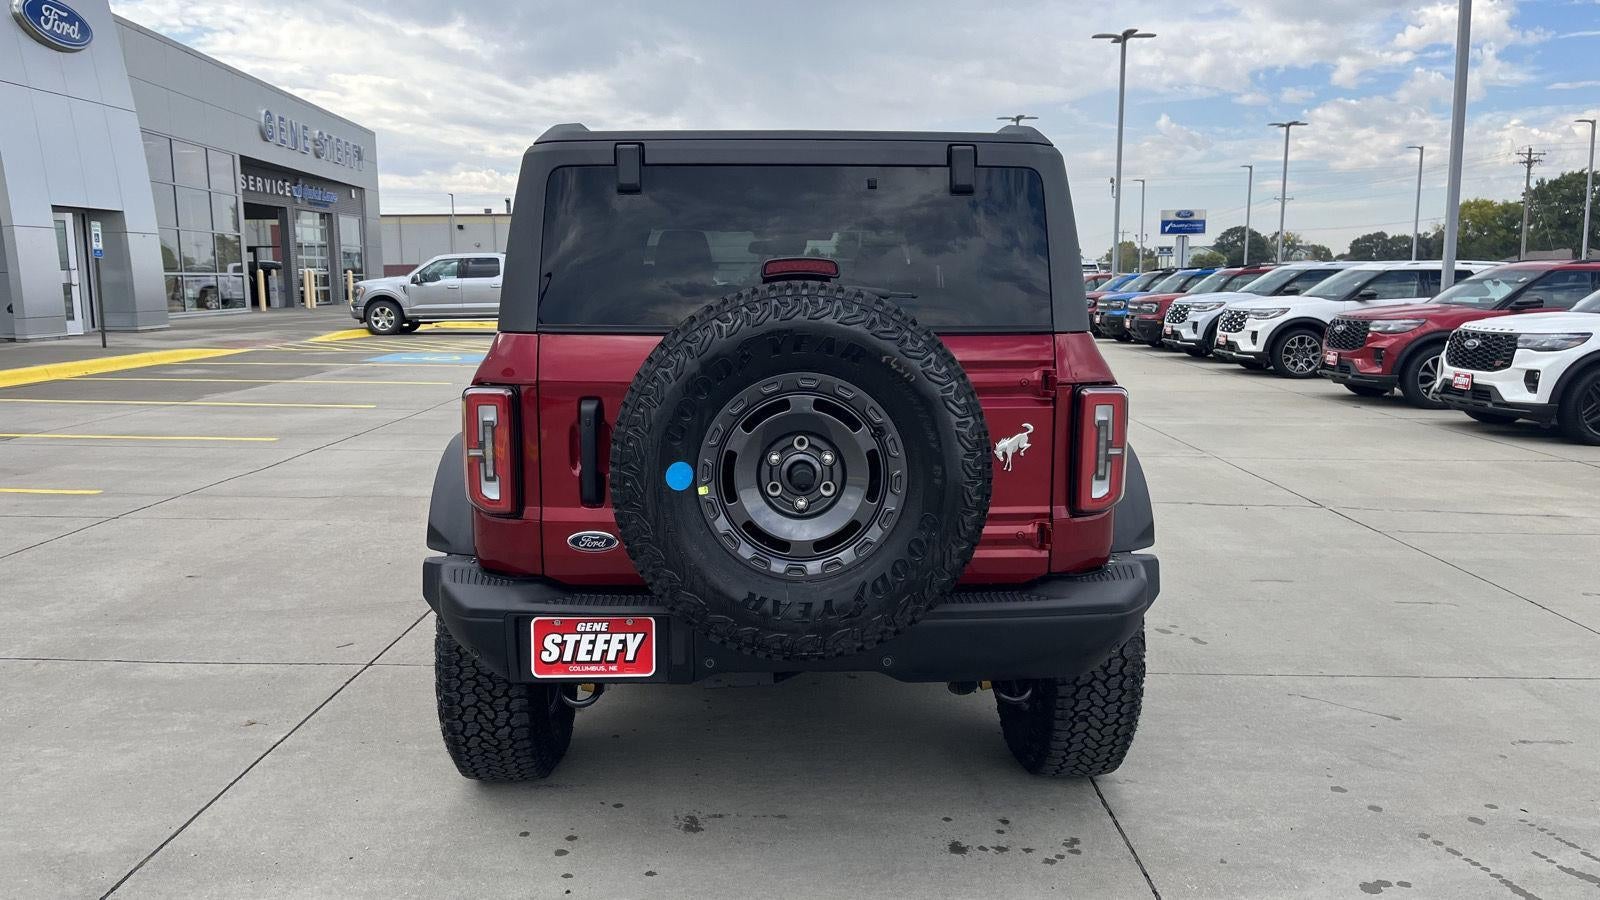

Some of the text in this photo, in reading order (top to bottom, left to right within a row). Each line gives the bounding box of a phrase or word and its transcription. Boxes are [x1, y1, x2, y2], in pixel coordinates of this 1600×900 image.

[41, 4, 80, 39] Ford
[260, 109, 365, 171] GENE STEFFY
[240, 174, 291, 197] SERVICE
[578, 535, 607, 549] Ford
[576, 622, 609, 632] GENE
[540, 633, 645, 663] STEFFY
